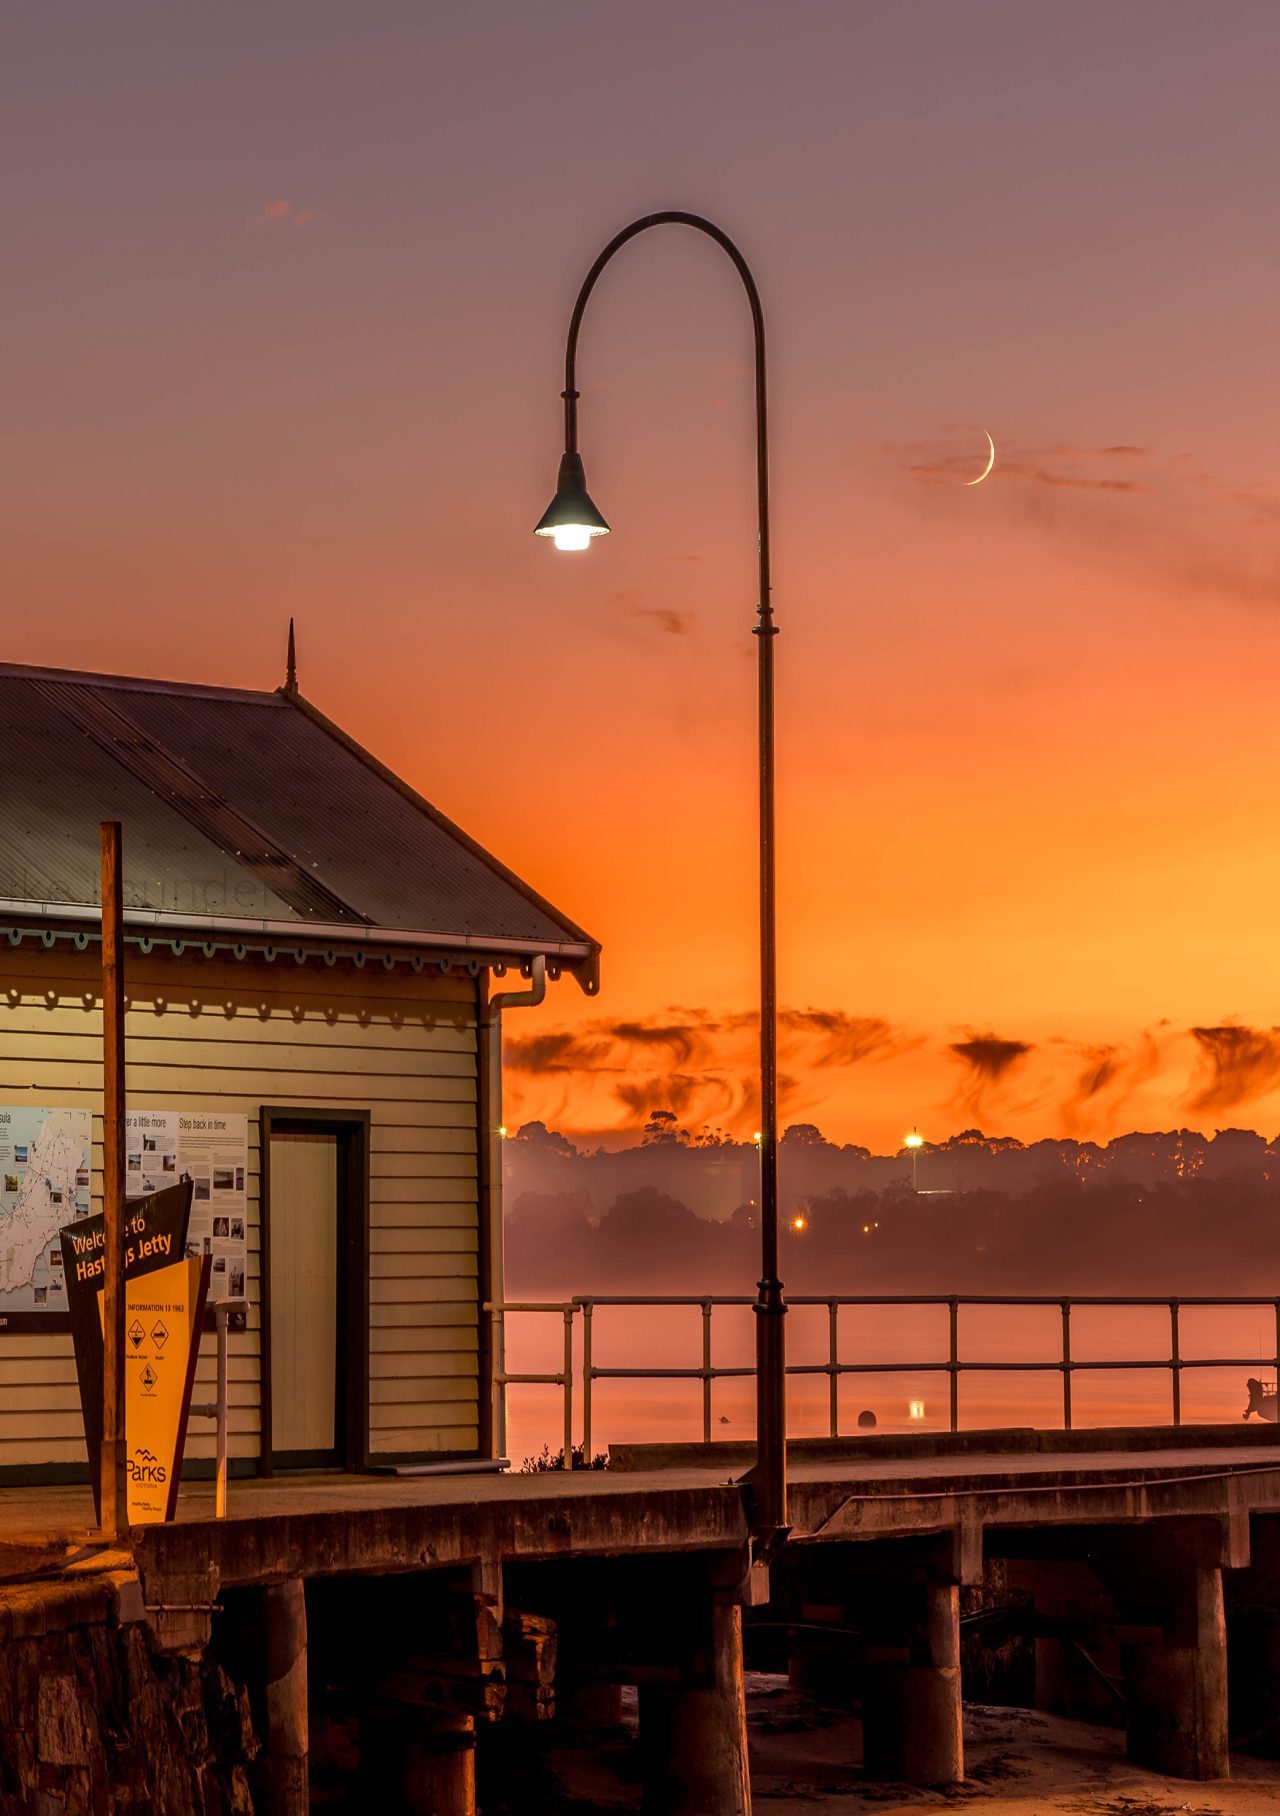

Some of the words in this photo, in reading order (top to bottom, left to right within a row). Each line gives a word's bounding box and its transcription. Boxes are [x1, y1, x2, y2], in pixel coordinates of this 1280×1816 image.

[138, 1116, 151, 1128] little
[151, 1118, 167, 1128] more
[179, 1117, 192, 1131] Step
[192, 1118, 207, 1129] back
[207, 1119, 213, 1129] in
[213, 1119, 226, 1130] time
[72, 1224, 129, 1256] Welc
[131, 1216, 145, 1234] to
[76, 1247, 134, 1281] Hasts
[138, 1234, 172, 1259] Jetty
[127, 1303, 163, 1312] INFORMATION
[165, 1304, 171, 1312] 13
[172, 1304, 185, 1313] 1963
[126, 1459, 167, 1483] Parks
